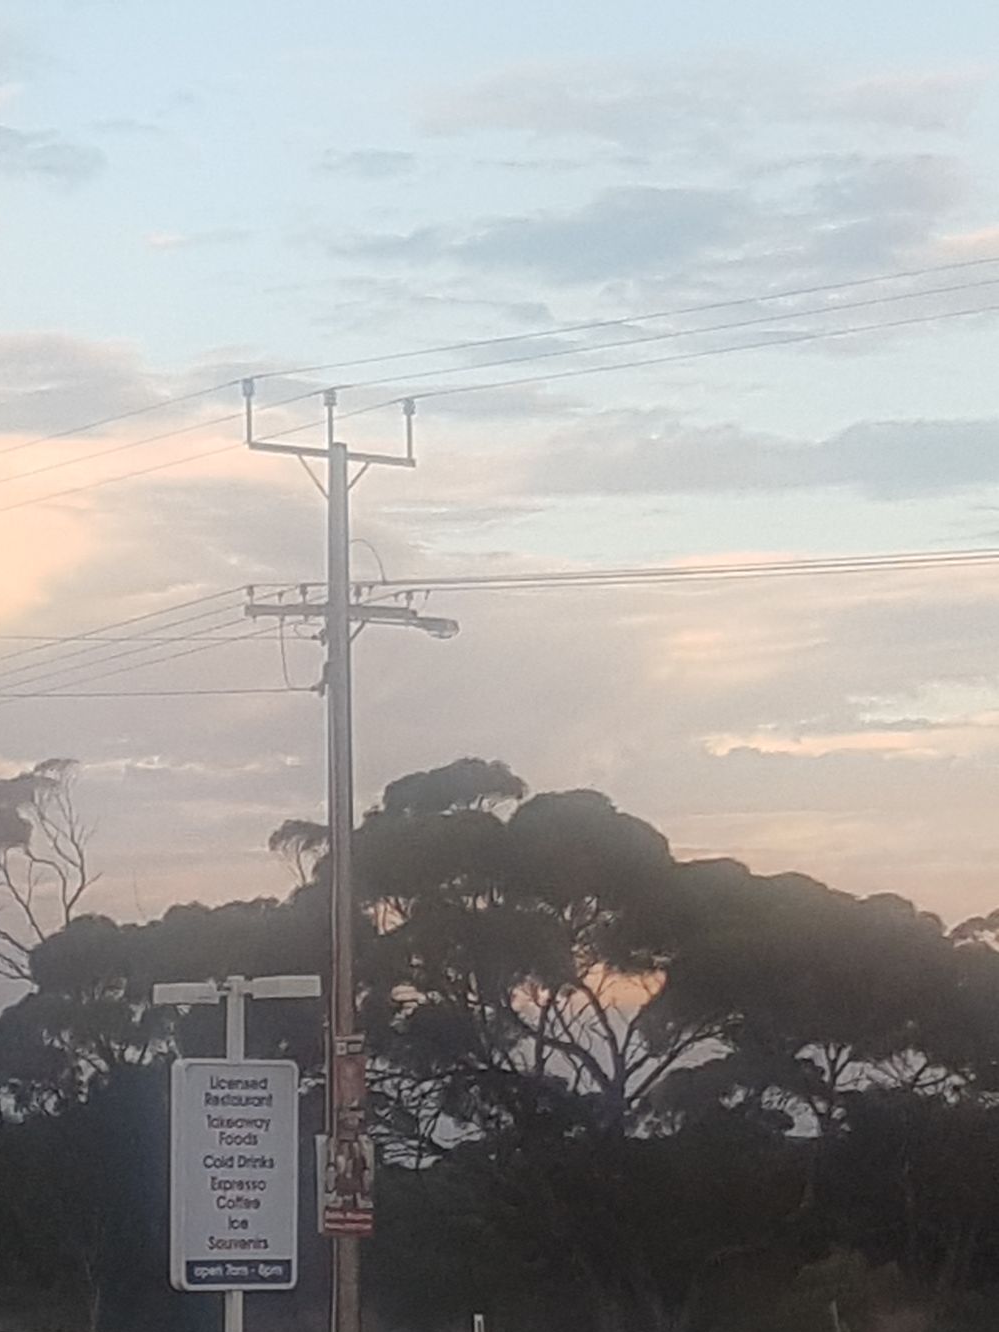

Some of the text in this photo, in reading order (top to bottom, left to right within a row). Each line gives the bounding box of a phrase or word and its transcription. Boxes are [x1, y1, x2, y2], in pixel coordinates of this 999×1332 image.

[209, 1076, 269, 1090] Licensed
[204, 1092, 273, 1107] Restaurant
[206, 1114, 271, 1132] Takeaway
[219, 1131, 259, 1146] Foods
[202, 1155, 275, 1169] Cold Drinks
[216, 1195, 261, 1209] Coffee
[228, 1215, 249, 1230] Ice
